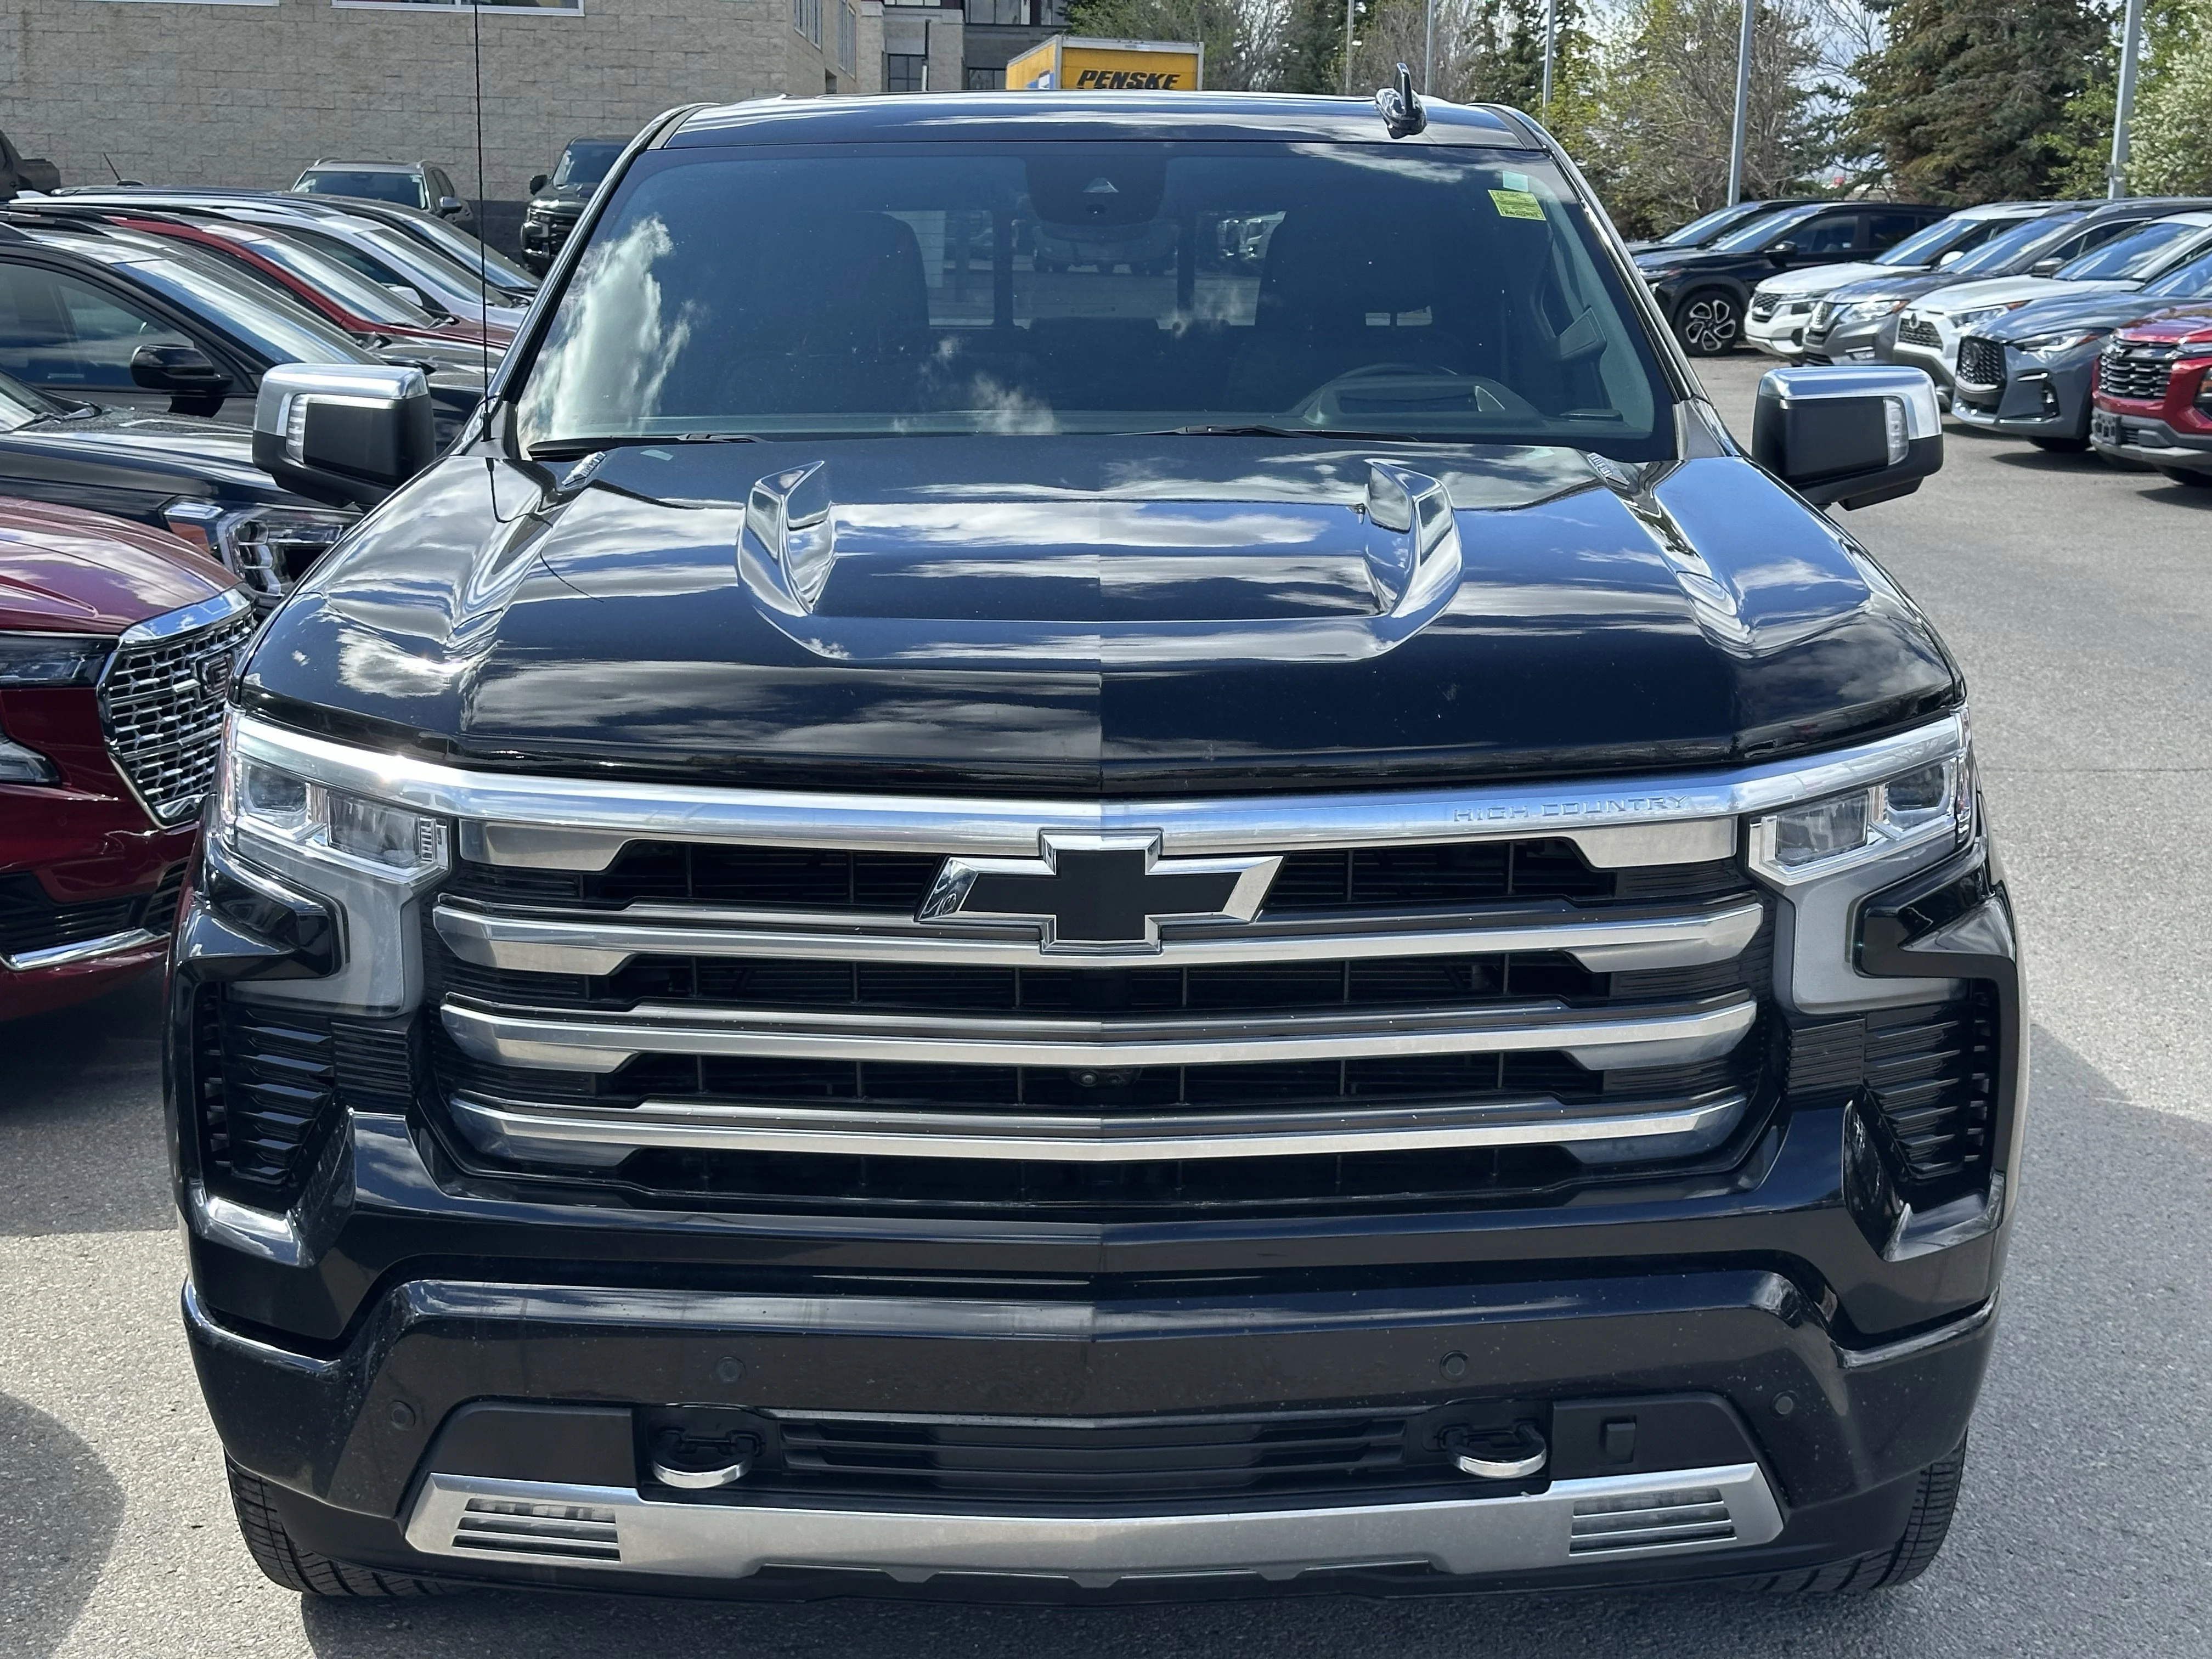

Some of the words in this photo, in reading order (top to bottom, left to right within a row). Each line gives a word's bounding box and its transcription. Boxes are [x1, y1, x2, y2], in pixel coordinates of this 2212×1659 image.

[1076, 70, 1181, 89] PENSKE
[1453, 805, 1530, 822] HIGH
[1541, 795, 1690, 817] COUNTRY
